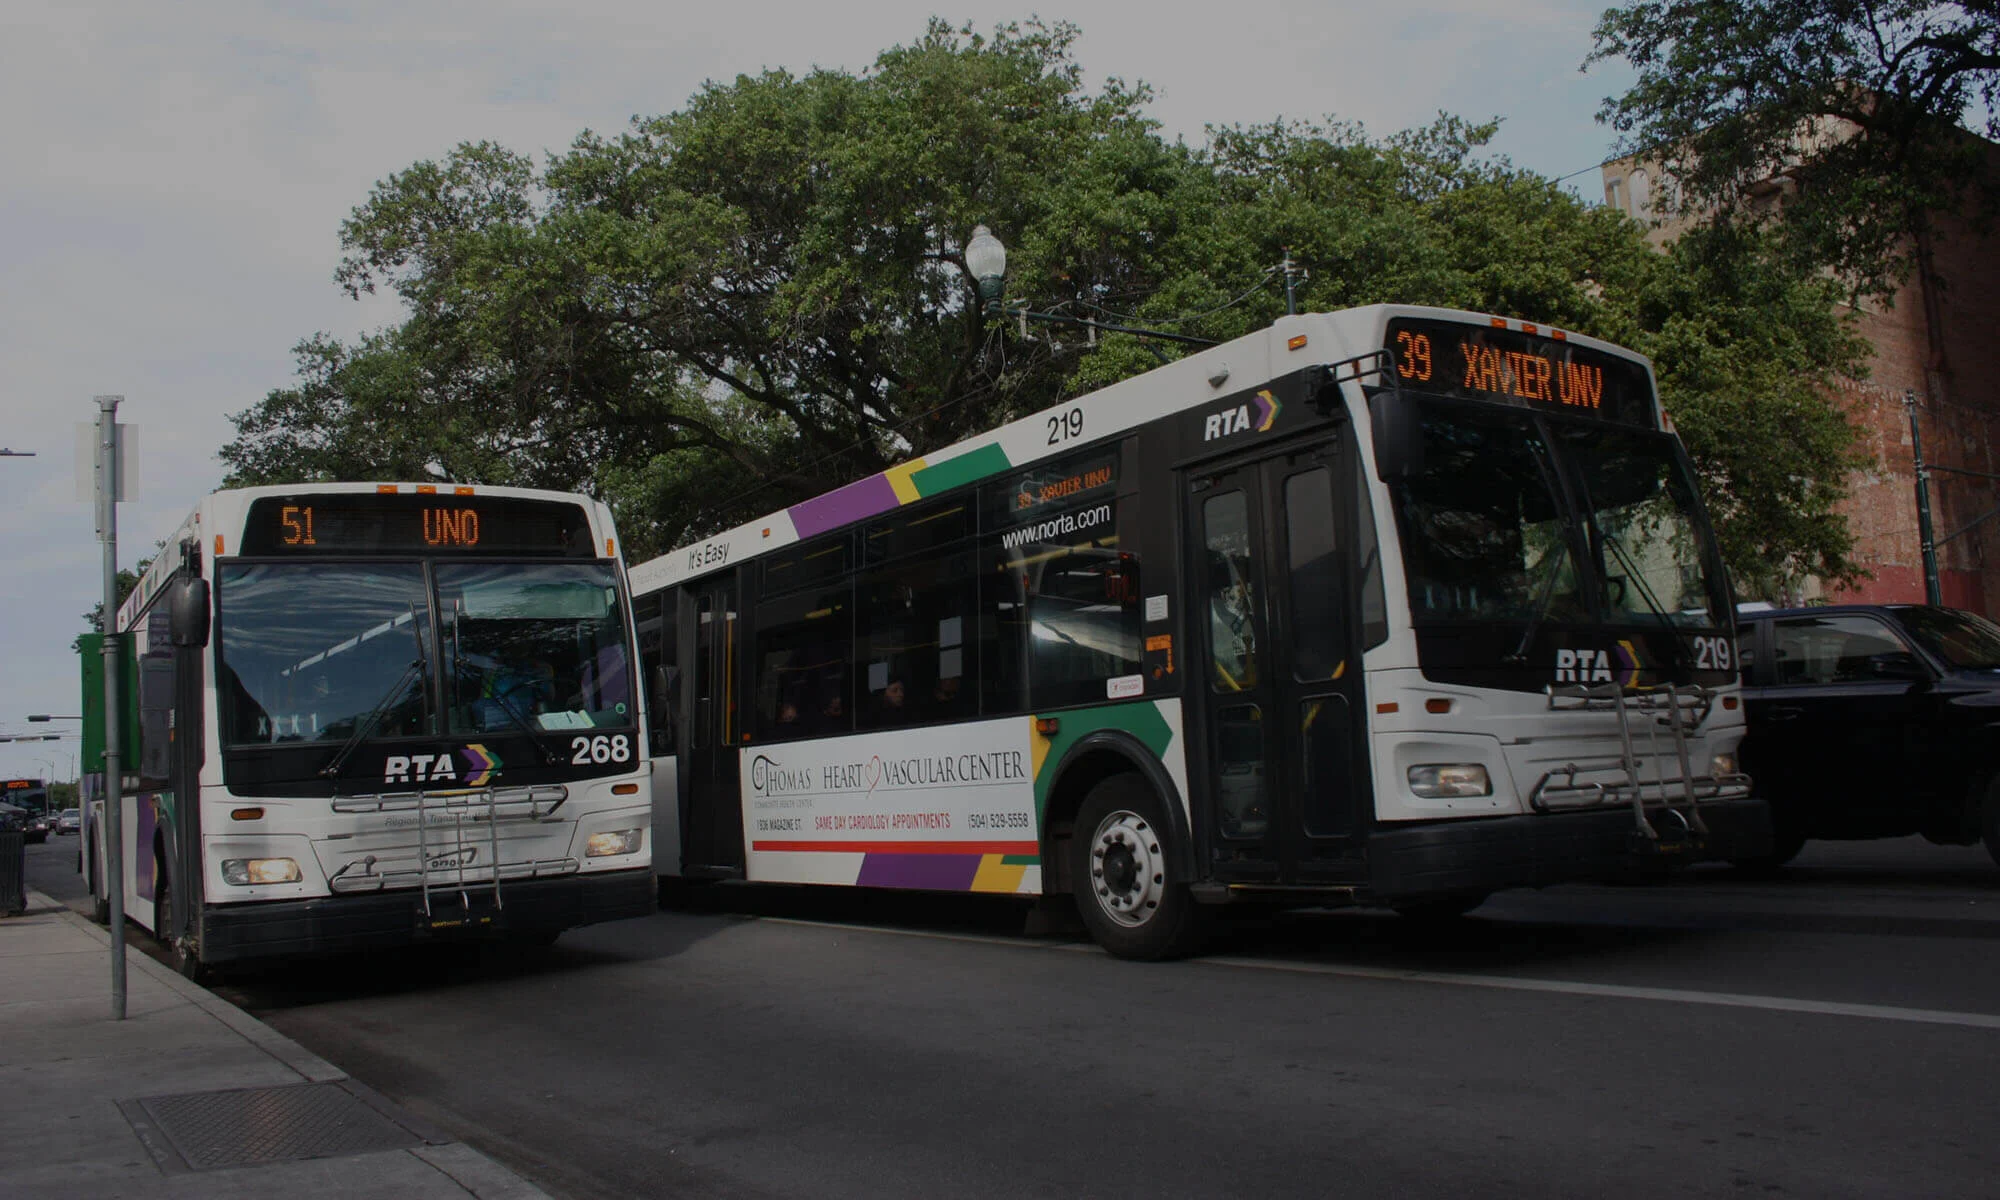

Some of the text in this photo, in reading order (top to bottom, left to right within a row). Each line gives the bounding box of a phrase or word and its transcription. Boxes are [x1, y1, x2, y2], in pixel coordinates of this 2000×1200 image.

[1396, 329, 1604, 409] 39 XAVIER UNV
[1047, 407, 1083, 446] 219
[1204, 404, 1251, 441] RTA
[1039, 475, 1082, 502] XAVIER
[1084, 465, 1111, 489] UNV
[281, 505, 480, 546] 51 UNO
[1001, 504, 1111, 550] www.norta.com
[688, 541, 730, 571] It's Easy
[1555, 648, 1614, 682] RTA
[1693, 635, 1731, 670] 219
[570, 733, 631, 767] 268
[384, 753, 457, 784] RTA
[752, 754, 811, 797] THOMAS
[823, 763, 863, 790] HEART
[883, 757, 956, 786] VASCULAR
[958, 751, 1025, 781] CENTER
[770, 818, 794, 831] MAGAZINE
[815, 811, 951, 831] SAME DAY CARDIOLOGY APPOINTMENTS
[968, 812, 1029, 829] (504) 529-5558
